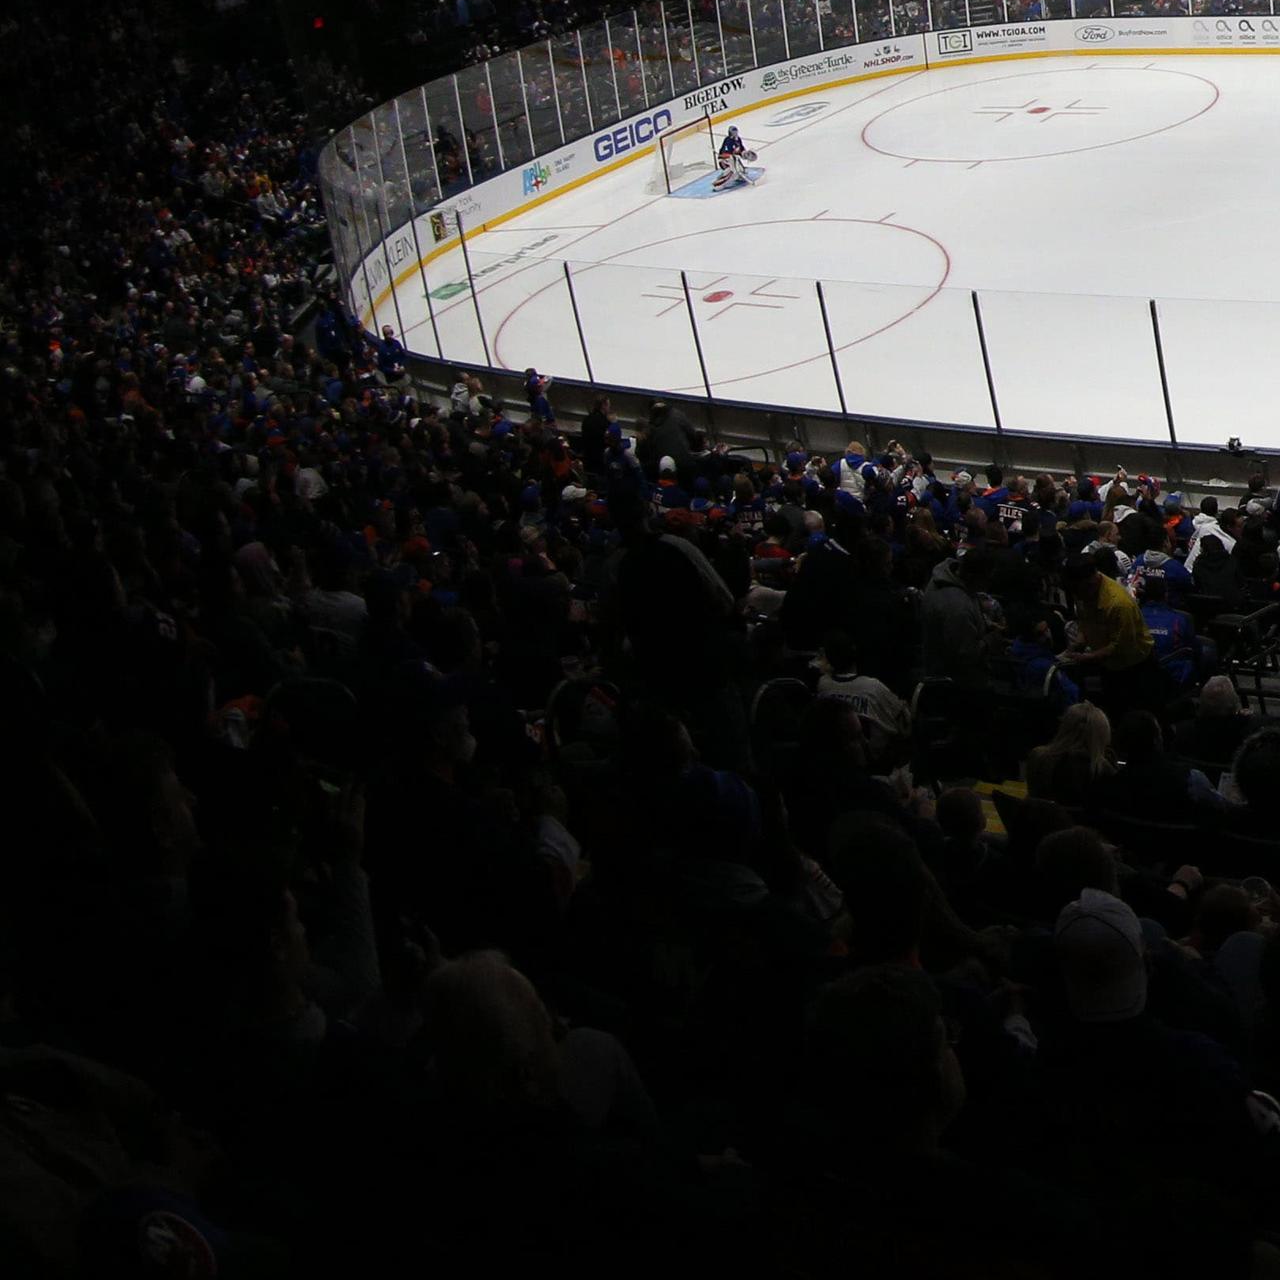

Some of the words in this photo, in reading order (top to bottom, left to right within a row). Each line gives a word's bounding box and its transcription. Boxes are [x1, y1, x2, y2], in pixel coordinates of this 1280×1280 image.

[941, 35, 968, 50] TGI
[1081, 28, 1109, 41] Ford
[789, 58, 824, 82] Greene
[683, 77, 744, 111] BIGELOW
[701, 97, 729, 117] TEA
[593, 108, 673, 162] GEICO
